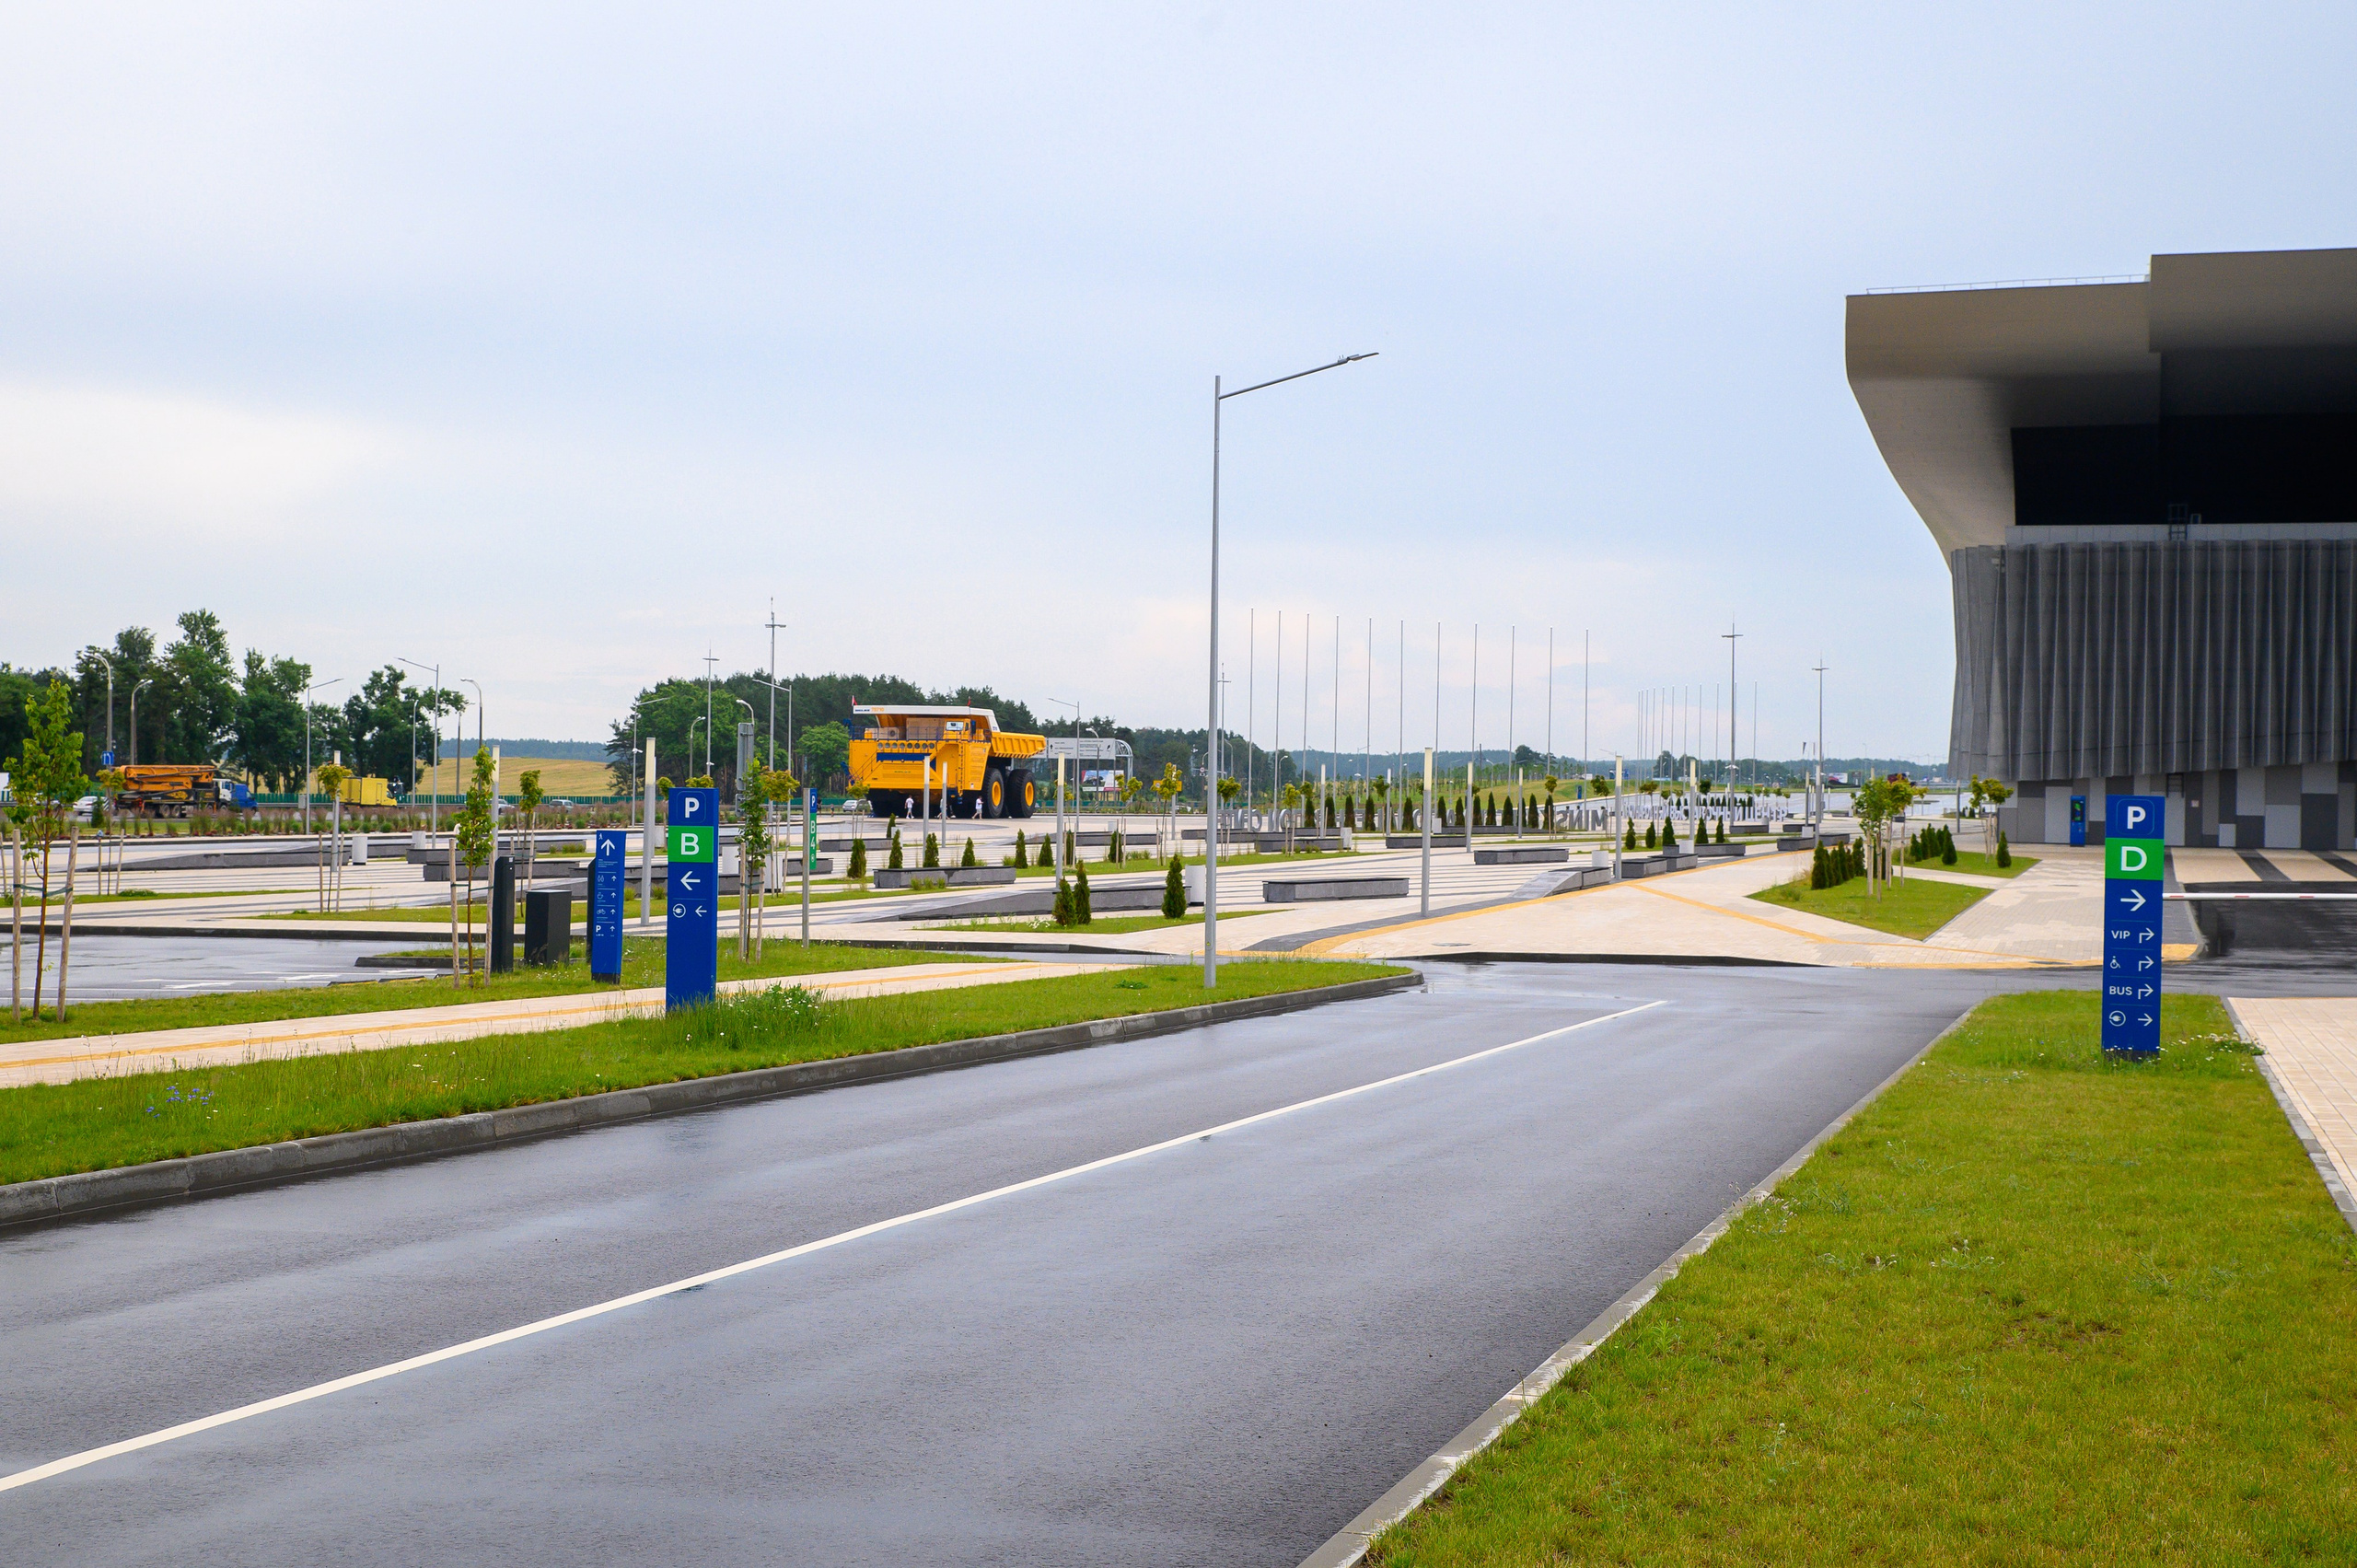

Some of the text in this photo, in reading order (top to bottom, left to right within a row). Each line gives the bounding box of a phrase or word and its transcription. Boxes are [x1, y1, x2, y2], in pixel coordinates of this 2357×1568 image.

[684, 797, 700, 819] P
[811, 796, 816, 807] P
[2127, 806, 2146, 830] P
[811, 820, 816, 834] B
[680, 832, 700, 855] B
[810, 836, 816, 850] 4
[2120, 845, 2148, 872] D
[596, 924, 602, 933] P
[2110, 930, 2131, 939] VIP
[2108, 985, 2133, 996] BUS
